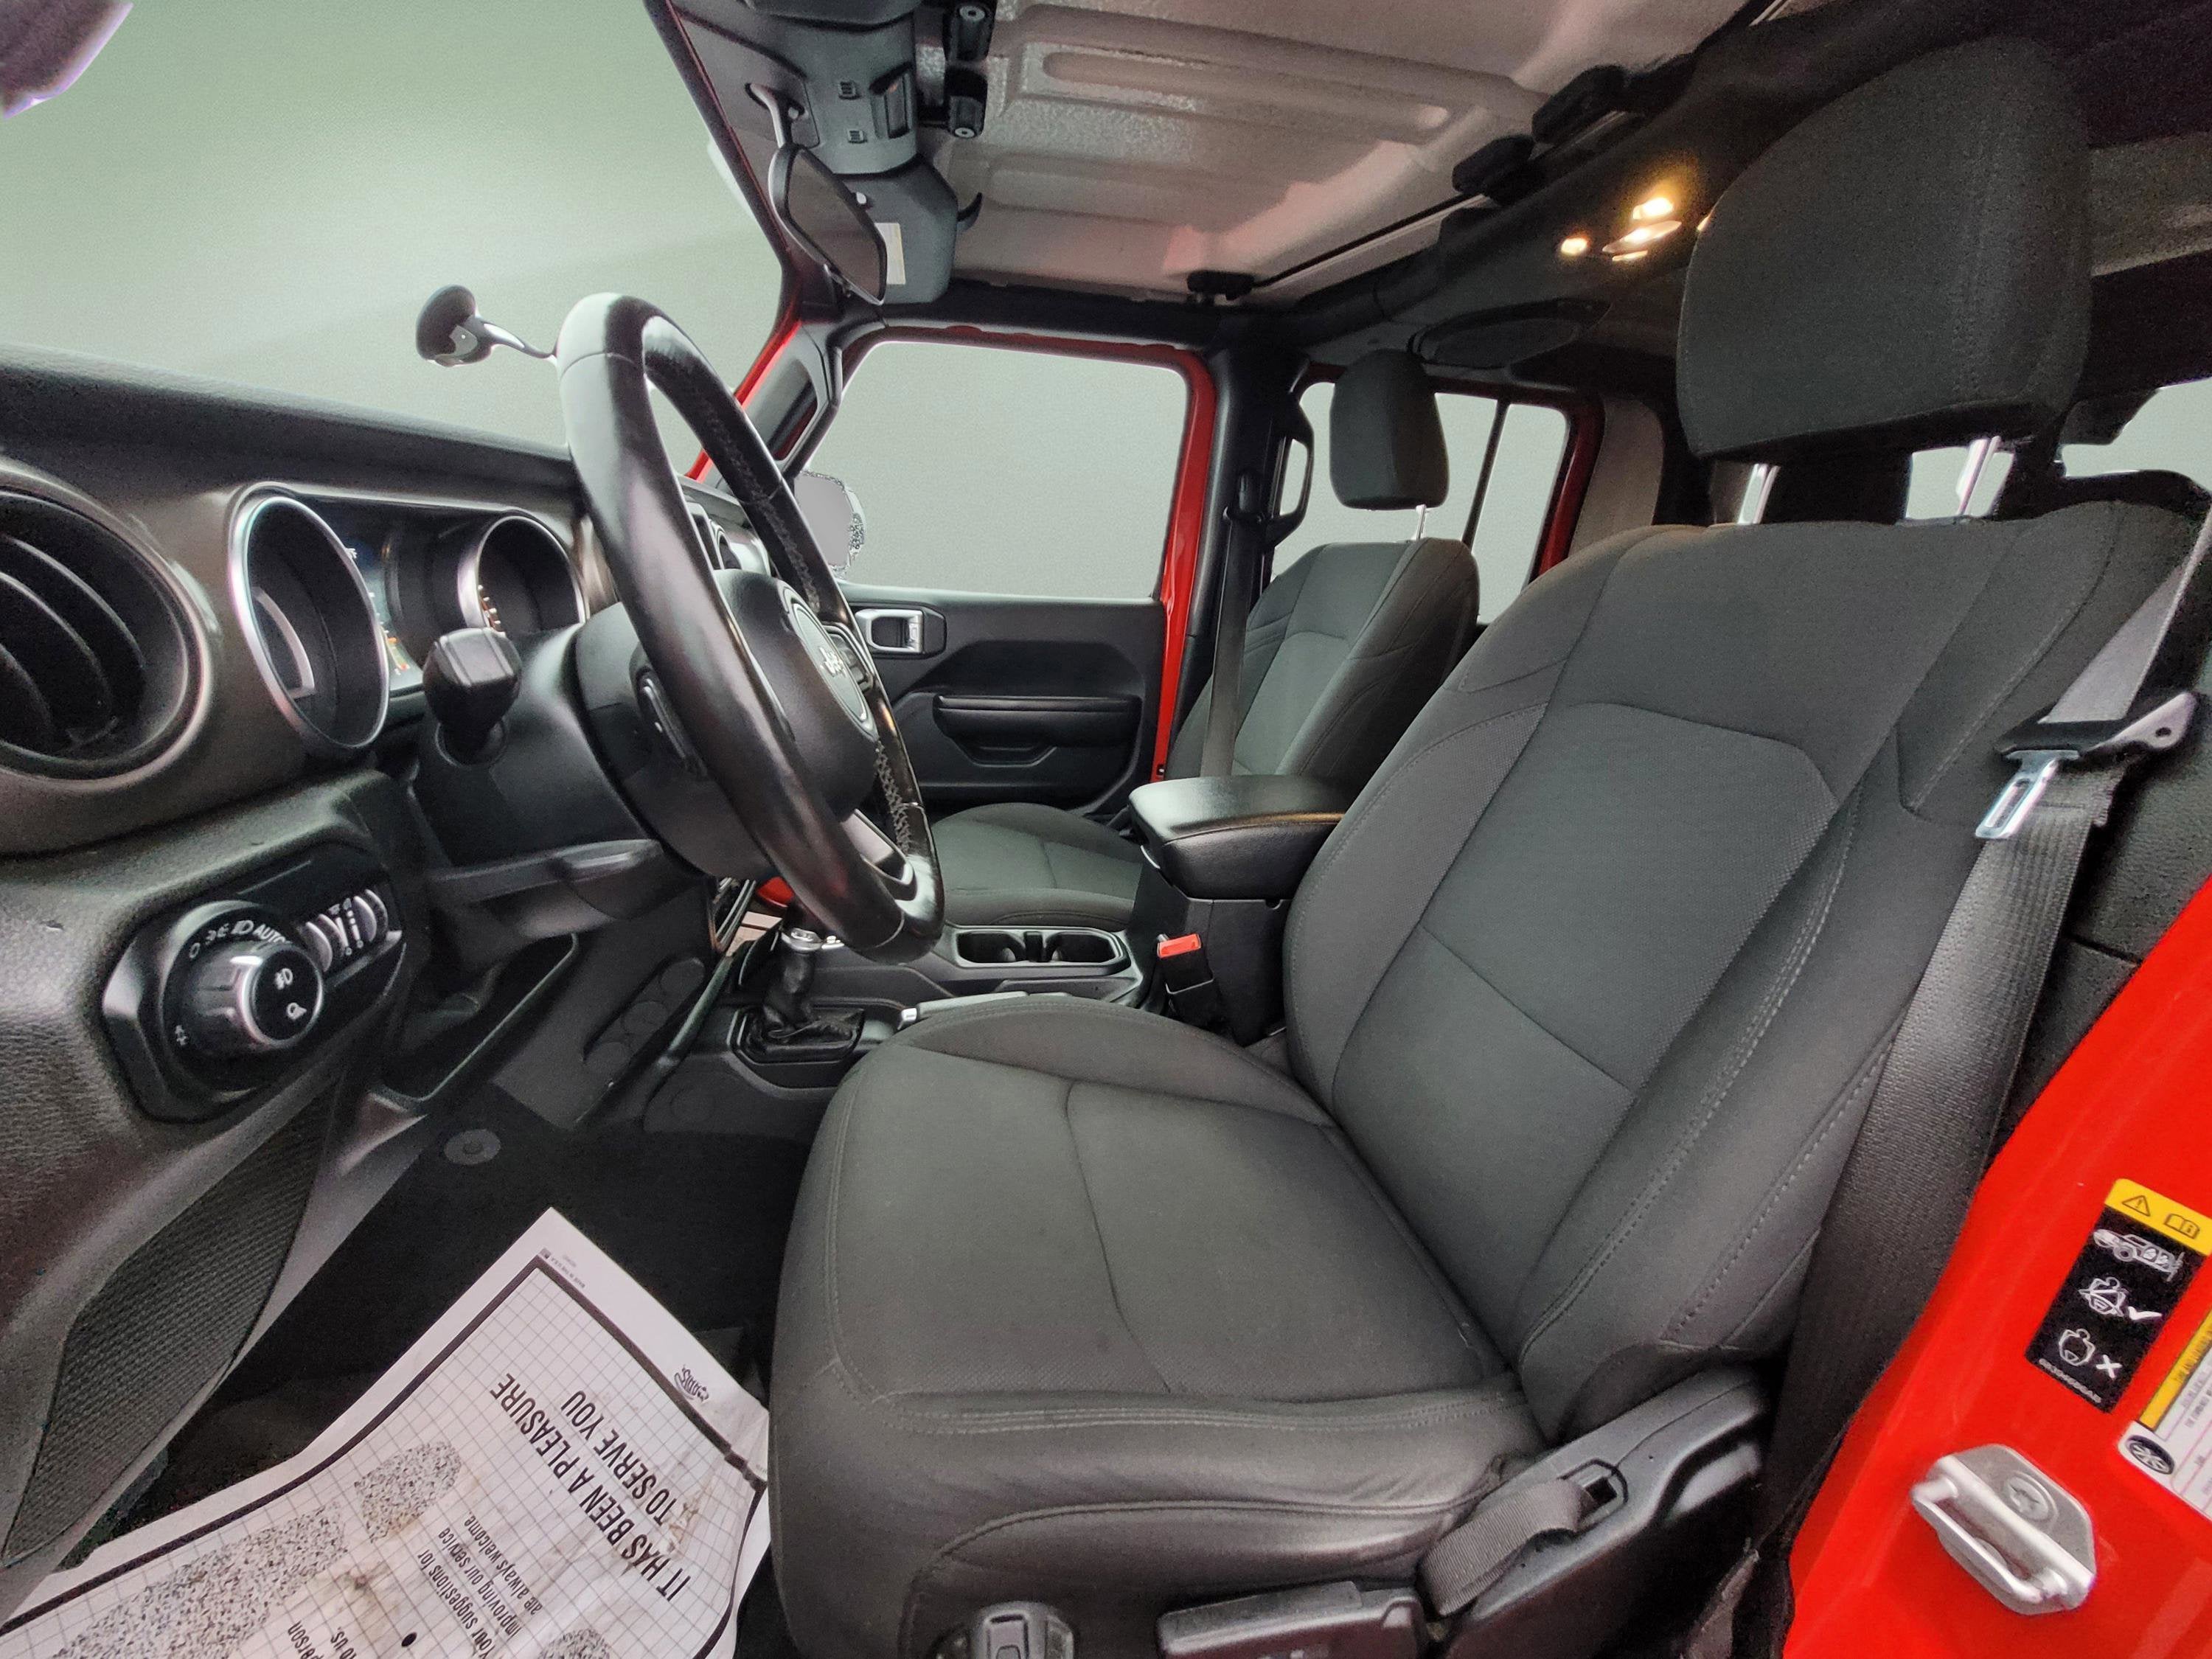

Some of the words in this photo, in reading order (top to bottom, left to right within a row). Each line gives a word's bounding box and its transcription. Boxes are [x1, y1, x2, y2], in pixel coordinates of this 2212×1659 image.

[490, 1373, 581, 1479] PLEASURE
[560, 1390, 605, 1441] YOU
[567, 1467, 595, 1494] A
[593, 1428, 657, 1500] SERVE
[579, 1484, 635, 1546] BEEN
[644, 1488, 678, 1526] TO
[438, 1527, 470, 1568] service
[464, 1511, 502, 1564] welcome.
[621, 1534, 672, 1582] HAS
[417, 1549, 436, 1571] for
[464, 1565, 484, 1585] our
[495, 1559, 530, 1600] always
[428, 1565, 479, 1630] suggestions
[655, 1568, 692, 1601] IT
[330, 1627, 349, 1651] us.
